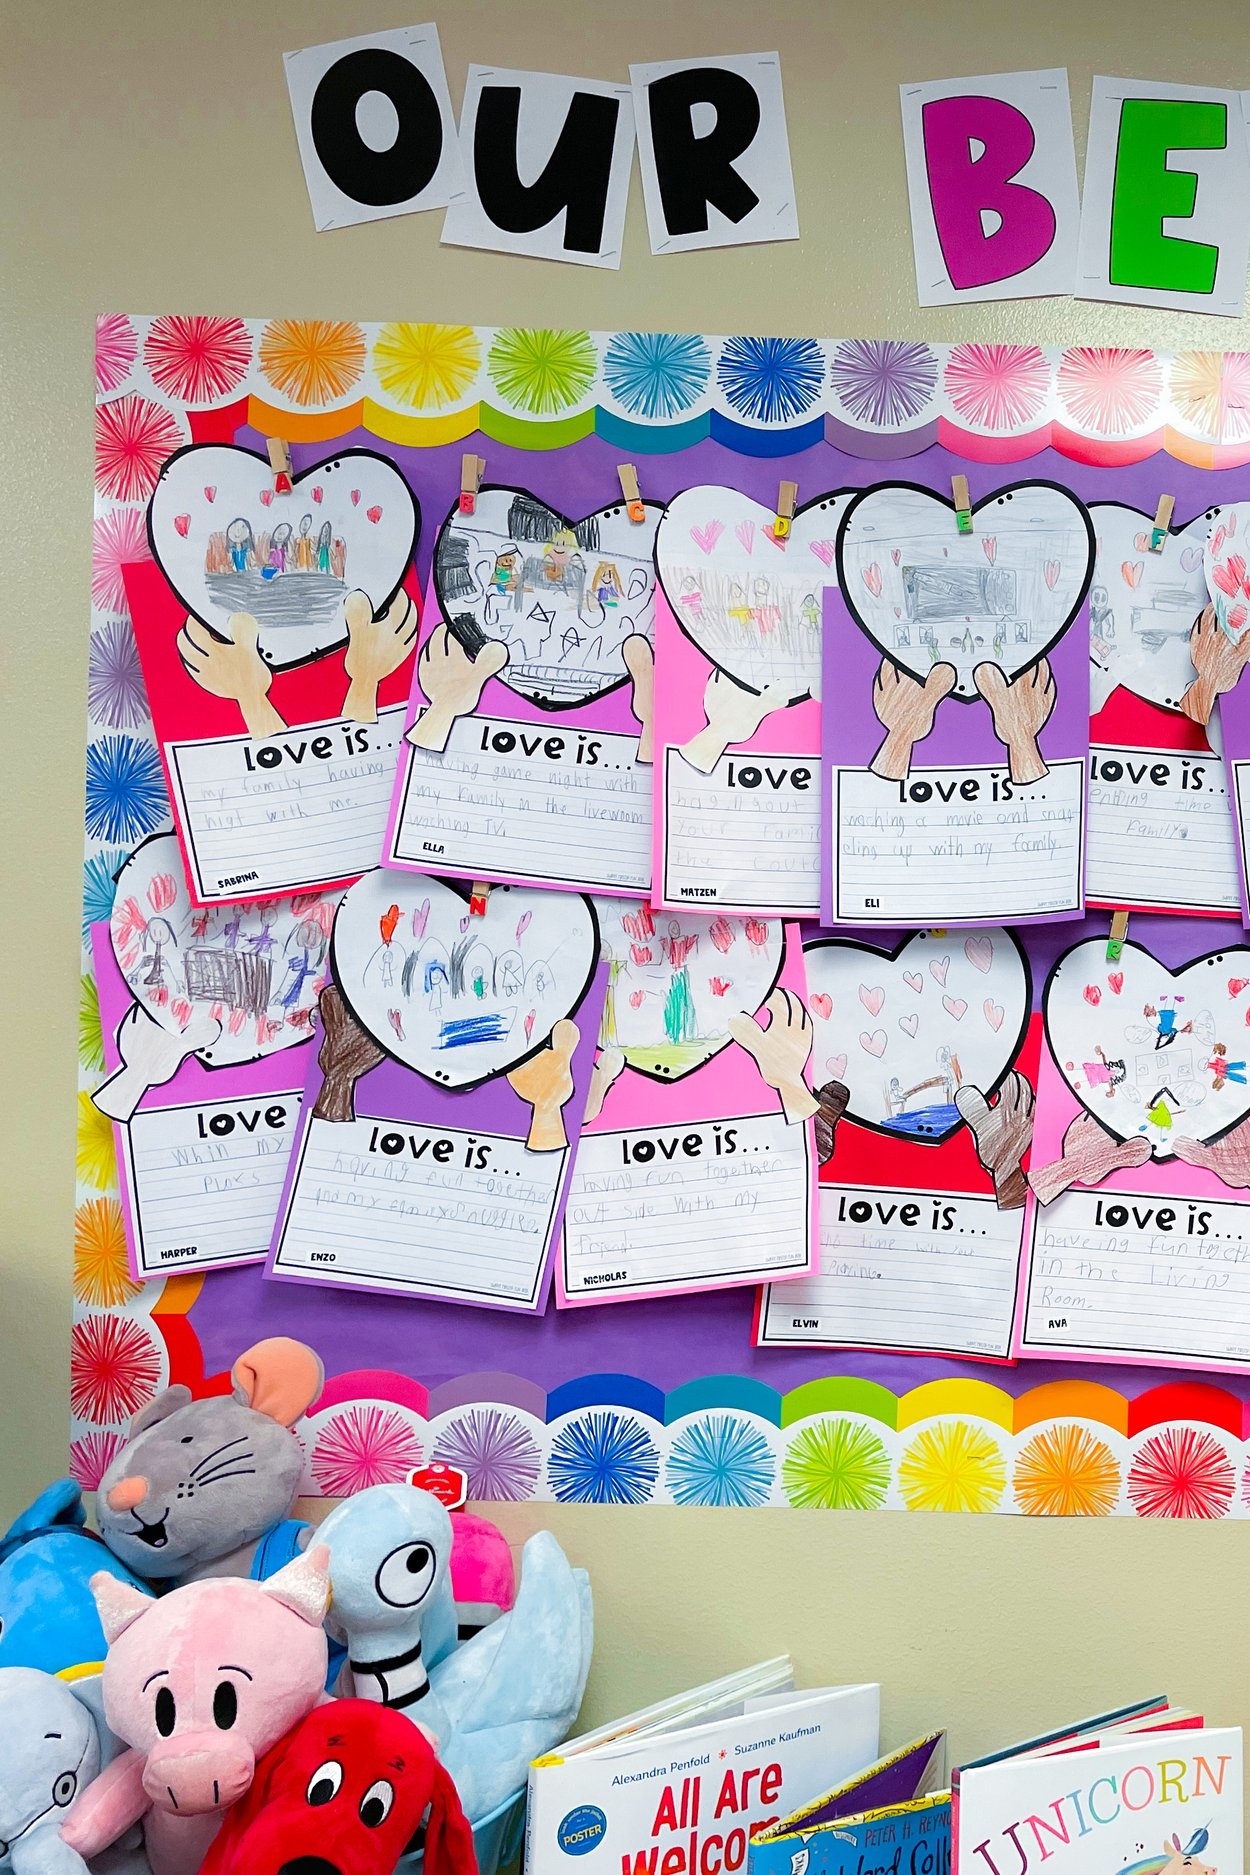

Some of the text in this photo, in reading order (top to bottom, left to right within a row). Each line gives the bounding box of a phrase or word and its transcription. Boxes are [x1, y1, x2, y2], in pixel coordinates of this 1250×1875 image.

[311, 48, 760, 254] OUR
[243, 736, 333, 772] love
[480, 726, 565, 759] love
[728, 762, 812, 790] love
[1090, 755, 1170, 785] love
[899, 777, 980, 802] love
[422, 841, 445, 855] ELLA
[218, 871, 259, 889] SABRINA
[680, 888, 717, 897] MATZEN
[865, 898, 880, 908] ELI
[198, 1105, 287, 1139] love
[368, 1127, 454, 1163] love
[622, 1133, 703, 1164] love
[838, 1196, 921, 1227] love
[1095, 1200, 1176, 1231] love
[161, 1246, 198, 1260] HARPER
[310, 1252, 336, 1262] ENZO
[584, 1271, 627, 1286] NICHOLAS
[793, 1319, 818, 1329] ELVIN
[1048, 1318, 1067, 1329] AVA
[611, 1724, 821, 1786] Alexandra Penfold Suzanne Kaufman
[651, 1776, 701, 1837] All
[714, 1762, 784, 1819] Are
[972, 1755, 1232, 1875] UNICORN
[563, 1824, 603, 1847] POSTER
[864, 1827, 896, 1848] PETER
